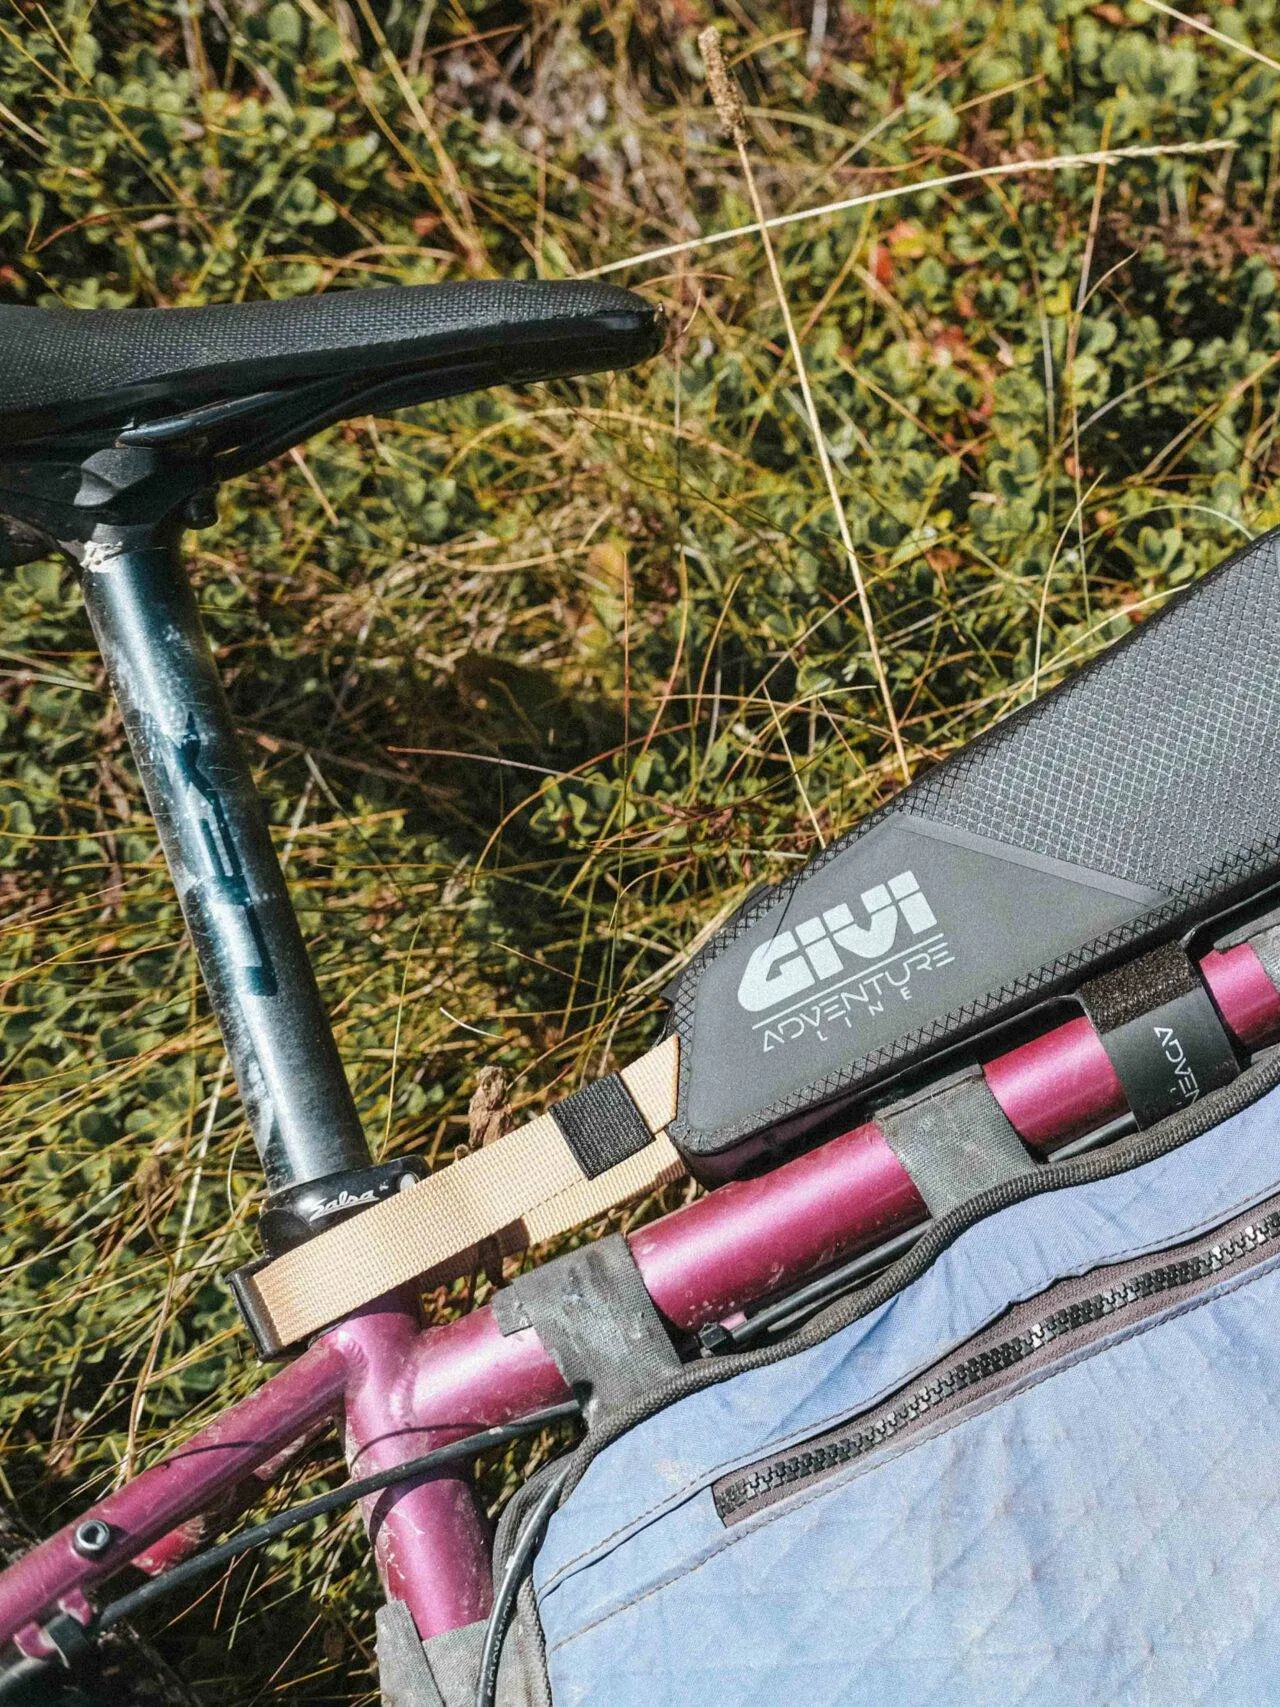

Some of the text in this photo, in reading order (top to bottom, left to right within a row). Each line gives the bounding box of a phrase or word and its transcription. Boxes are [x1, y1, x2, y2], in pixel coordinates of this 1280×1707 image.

[737, 870, 938, 1012] GIVI
[763, 942, 956, 1053] ADVENTURE
[816, 986, 913, 1042] LINE
[1153, 1026, 1201, 1105] ADVEN
[308, 1189, 380, 1223] Salsa
